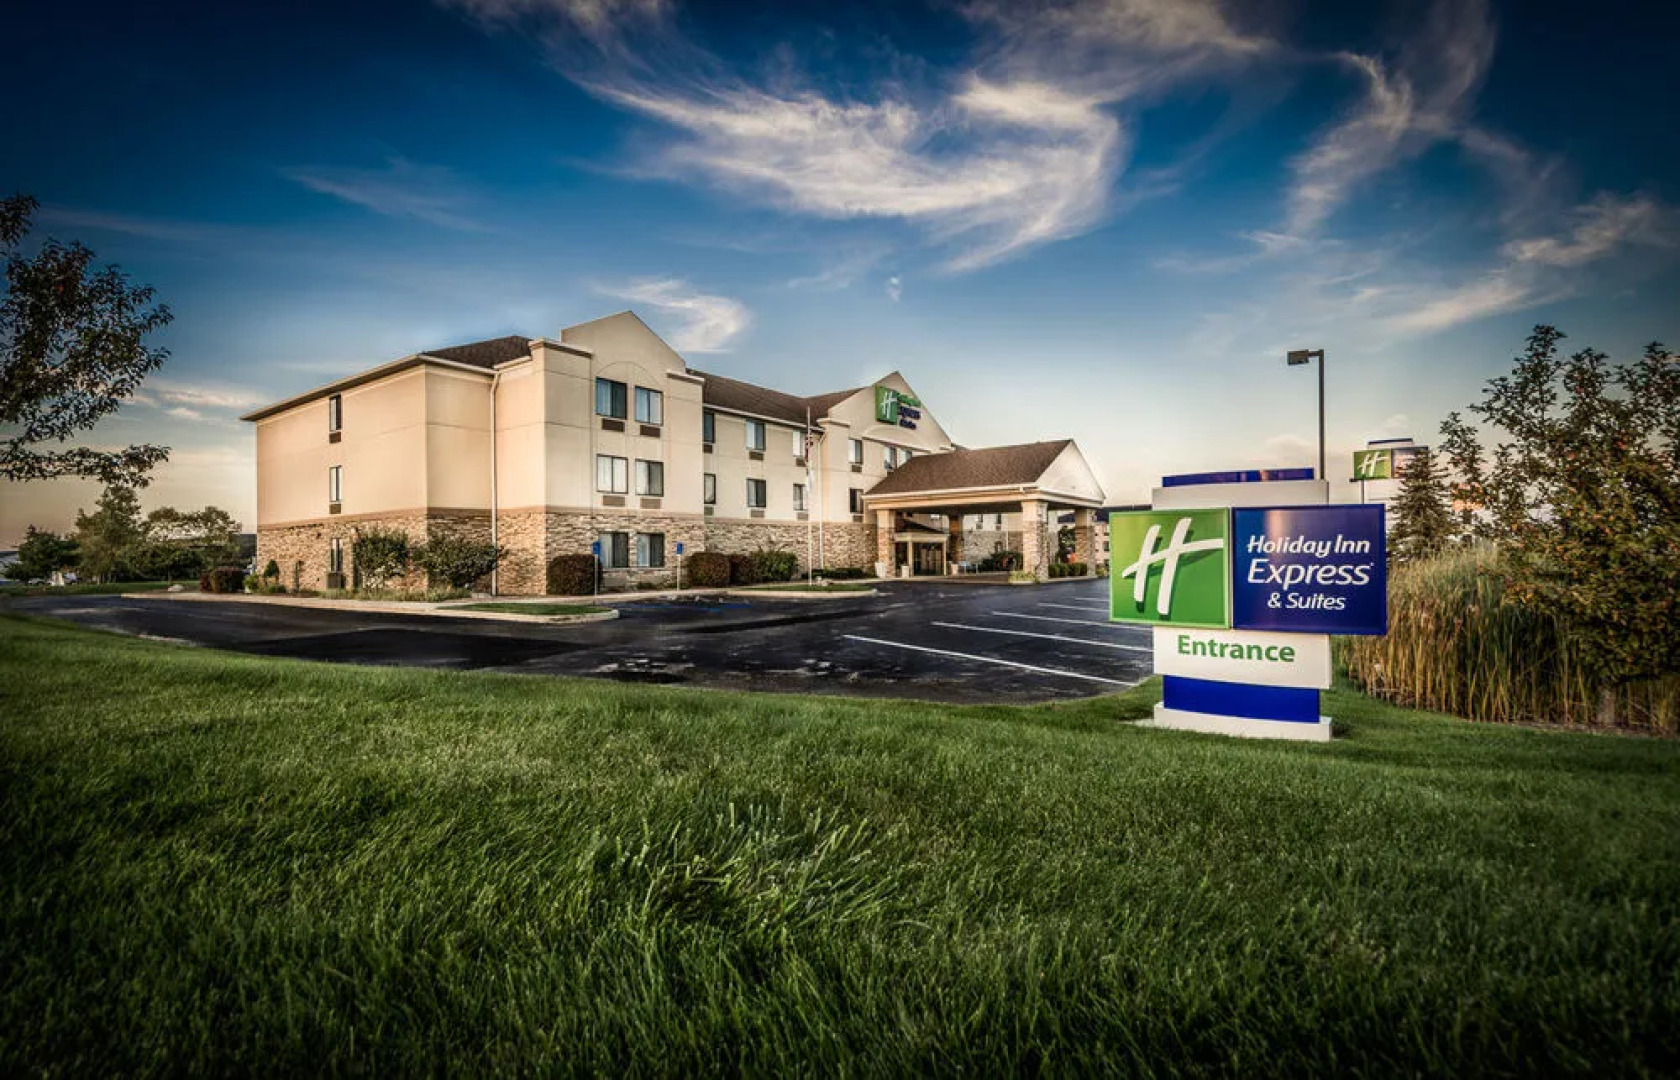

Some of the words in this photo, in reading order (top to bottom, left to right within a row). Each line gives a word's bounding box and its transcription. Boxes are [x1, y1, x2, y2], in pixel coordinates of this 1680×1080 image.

[1247, 535, 1332, 557] Holiday
[1335, 535, 1370, 554] Inn
[1247, 559, 1370, 589] Express
[1267, 592, 1281, 609] &
[1286, 592, 1346, 610] Suites
[1177, 635, 1295, 662] Entrance
